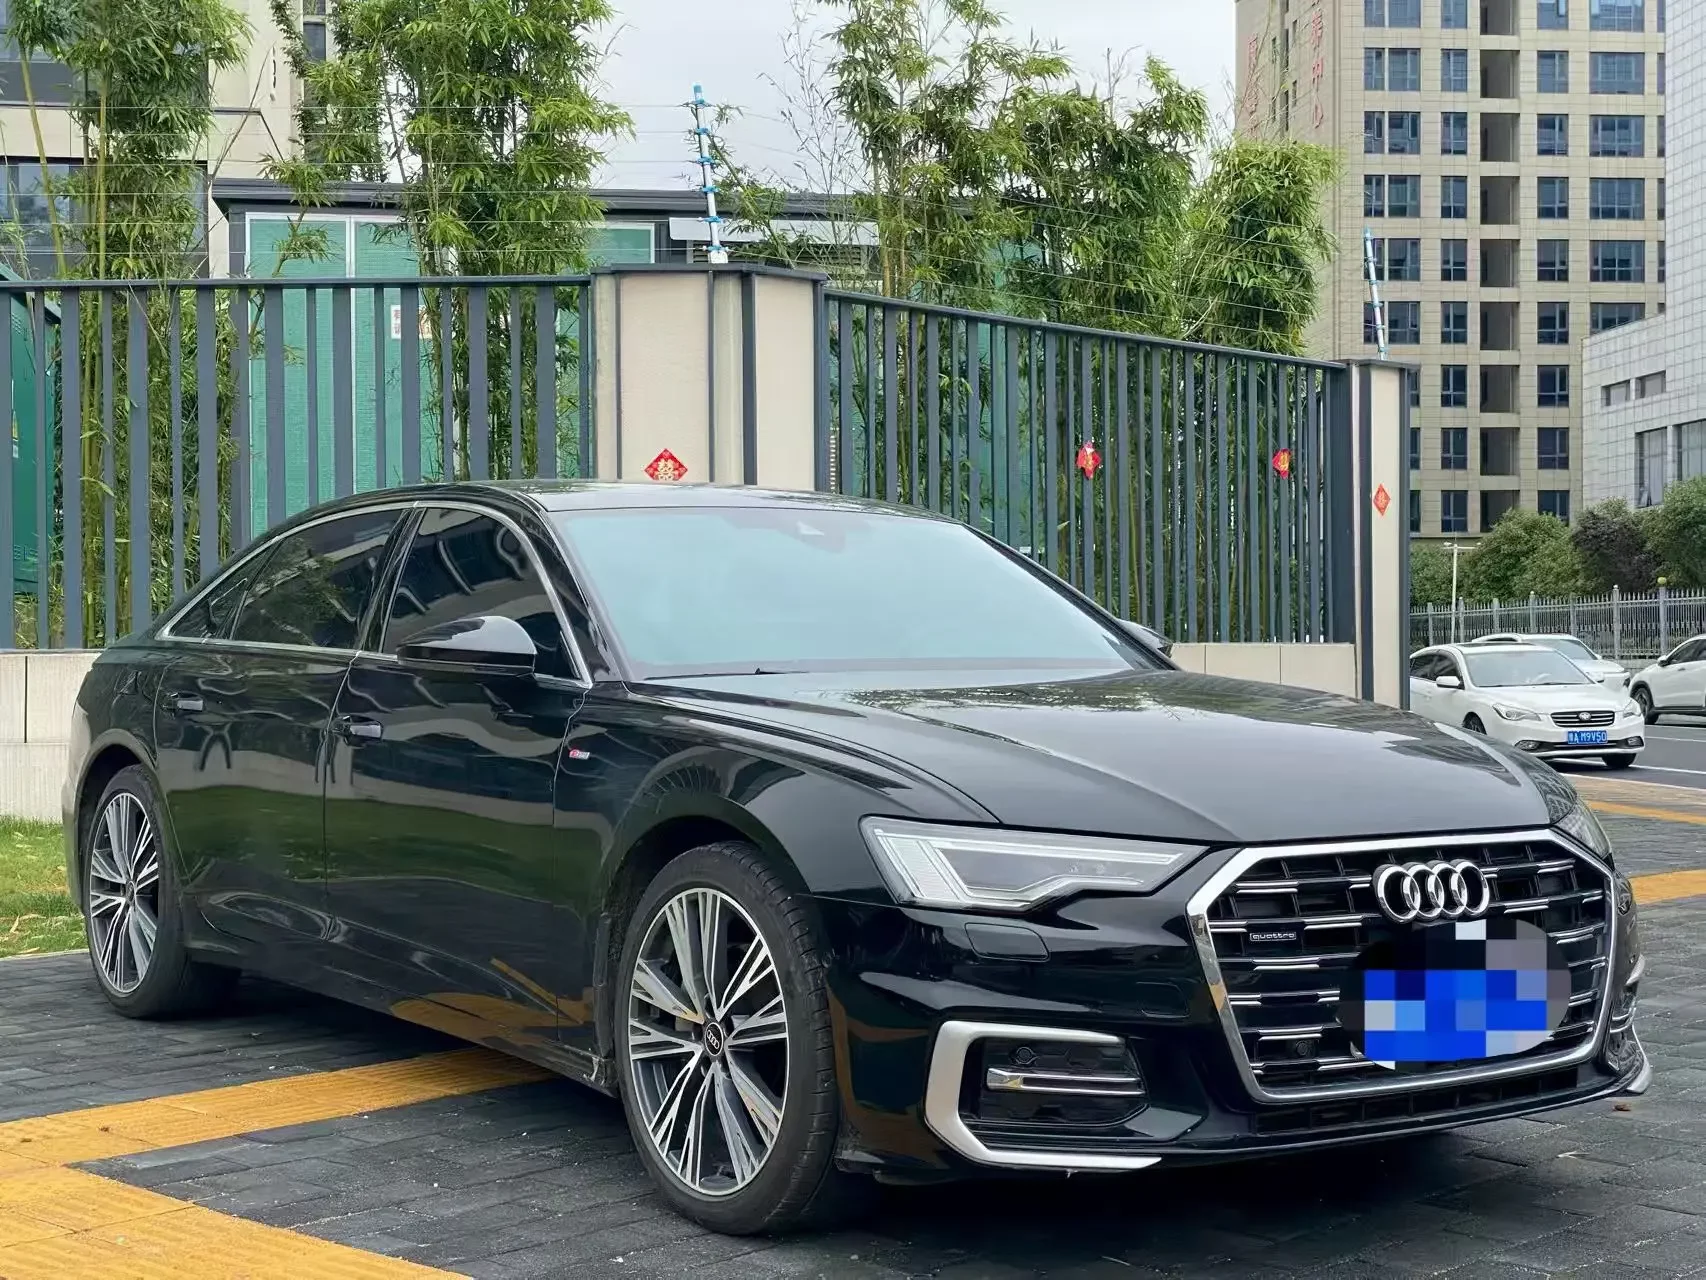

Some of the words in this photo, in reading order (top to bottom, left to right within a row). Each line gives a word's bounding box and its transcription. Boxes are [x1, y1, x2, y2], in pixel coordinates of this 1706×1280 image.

[1311, 0, 1324, 129] 养中心
[1252, 933, 1295, 941] quattro
